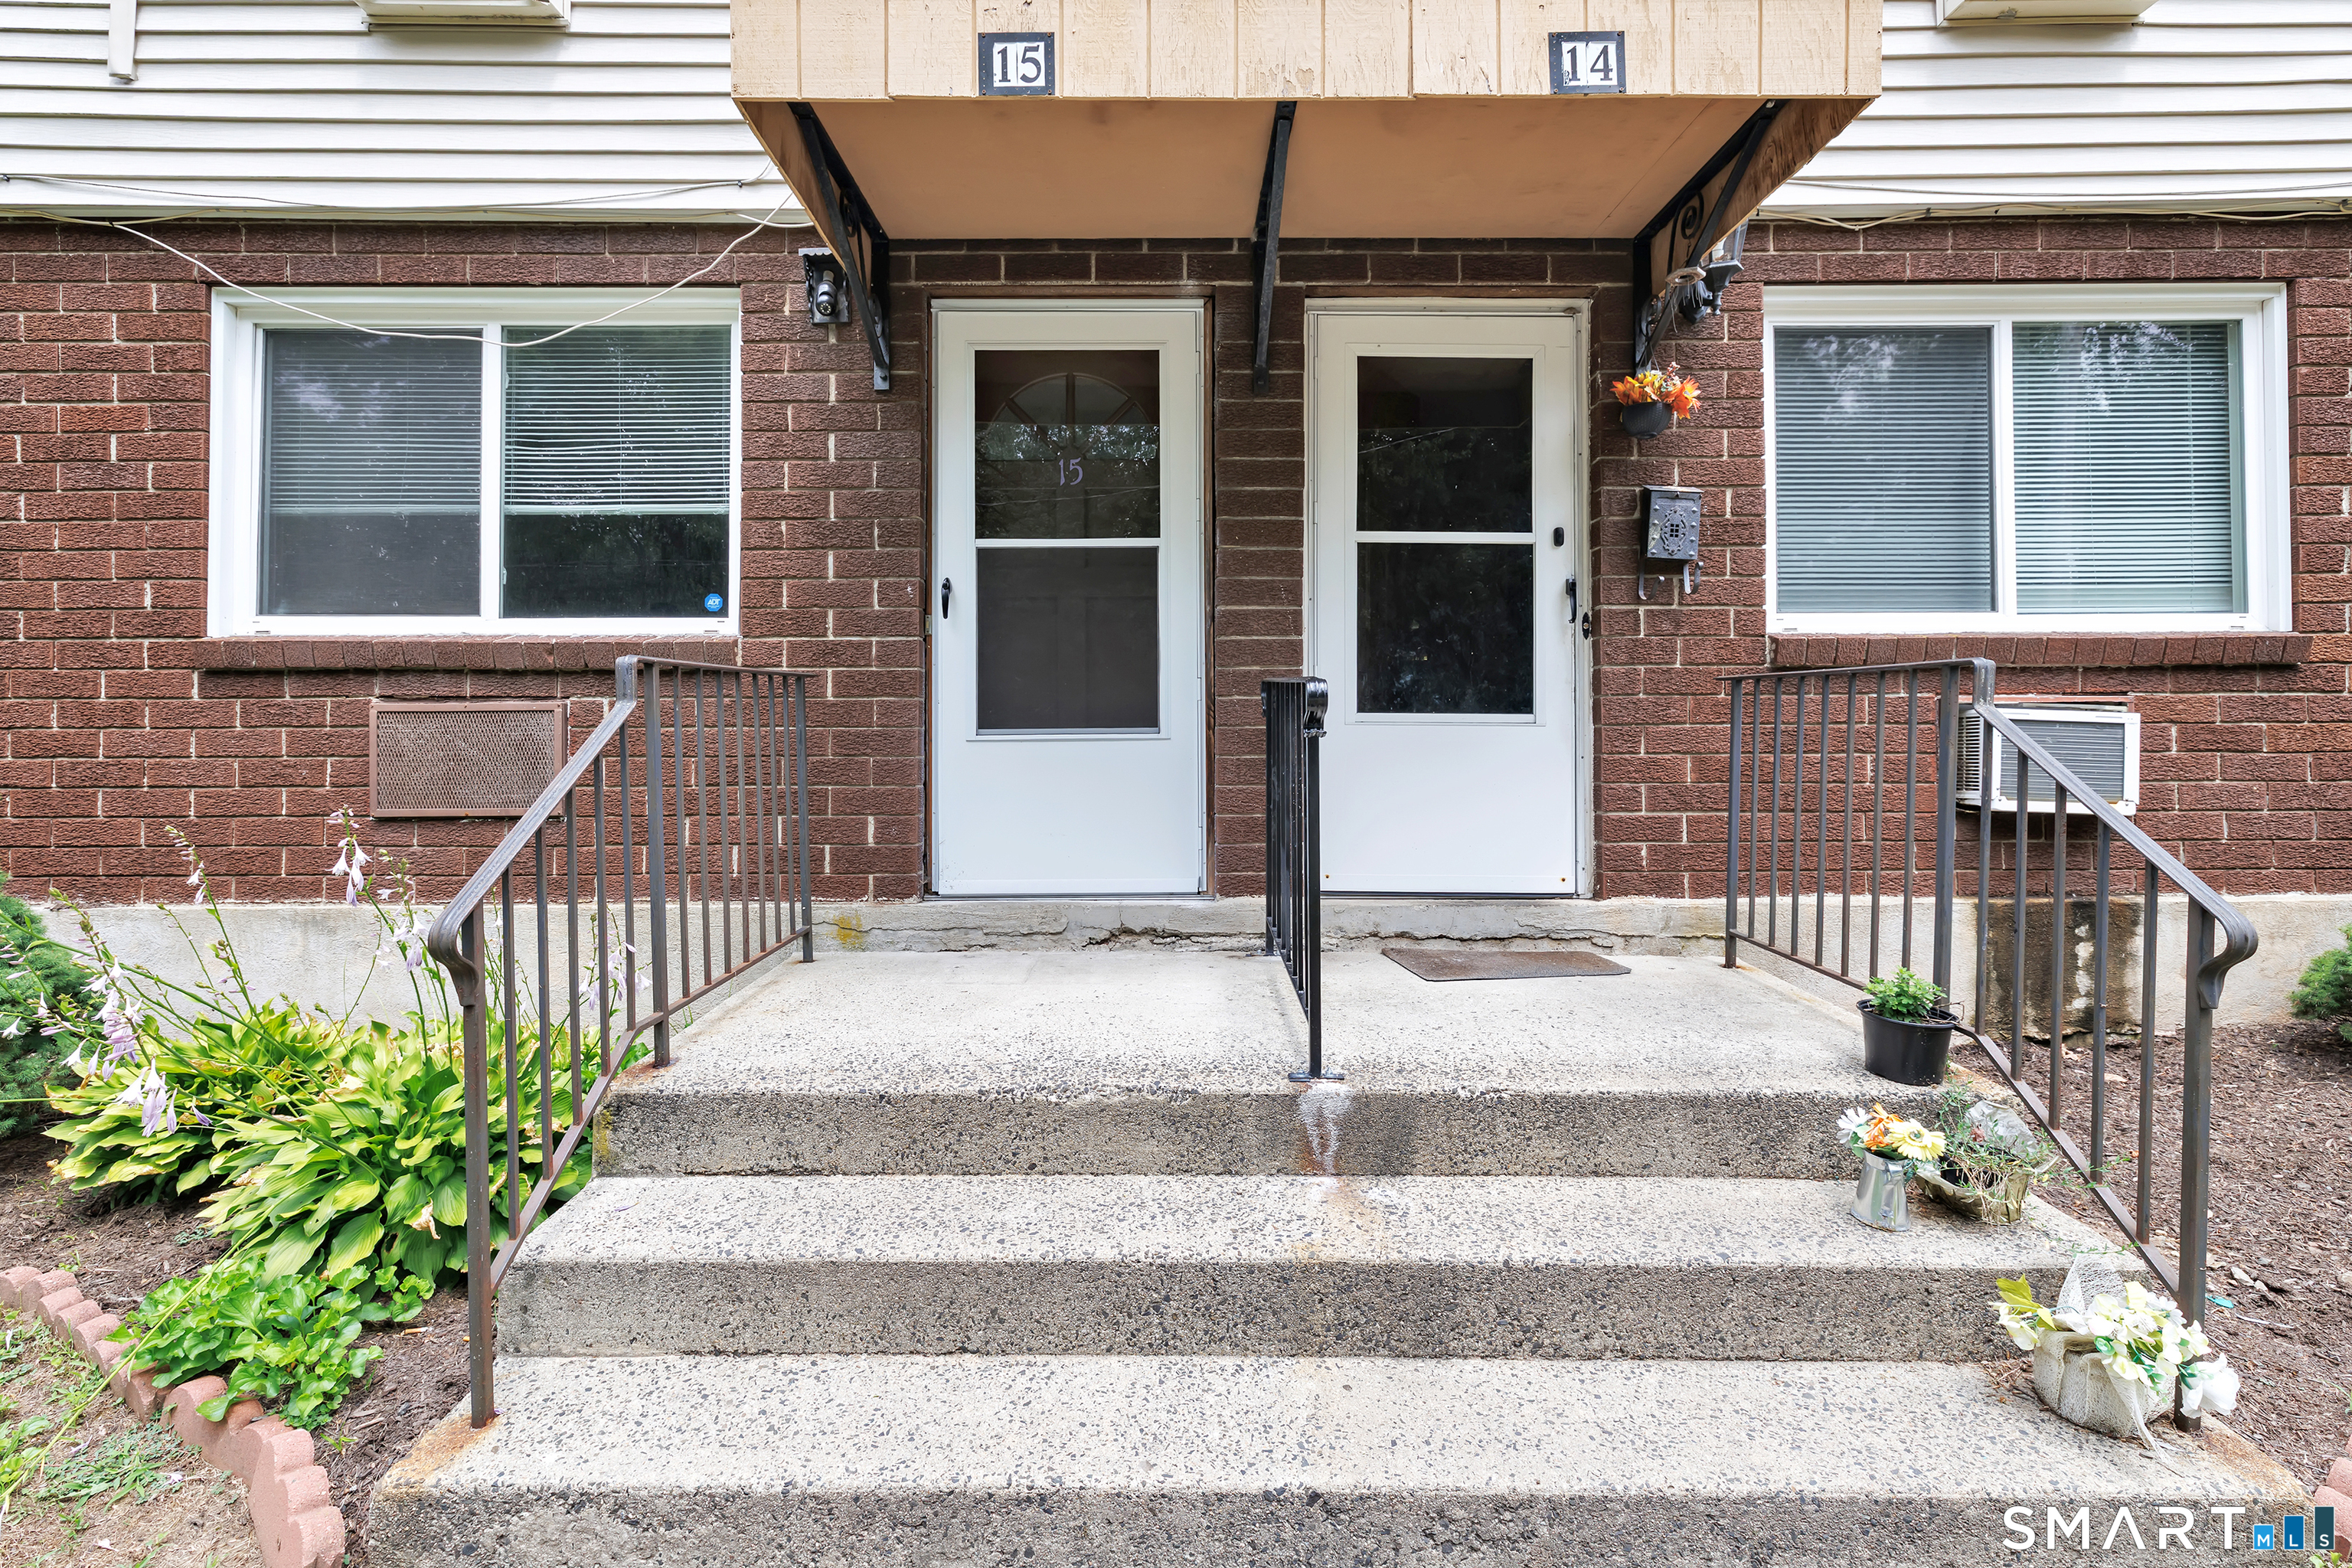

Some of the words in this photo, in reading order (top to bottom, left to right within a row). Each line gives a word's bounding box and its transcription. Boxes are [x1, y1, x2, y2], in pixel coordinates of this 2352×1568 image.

[998, 44, 1041, 83] 15
[1566, 44, 1613, 81] 14
[1058, 457, 1083, 486] 15
